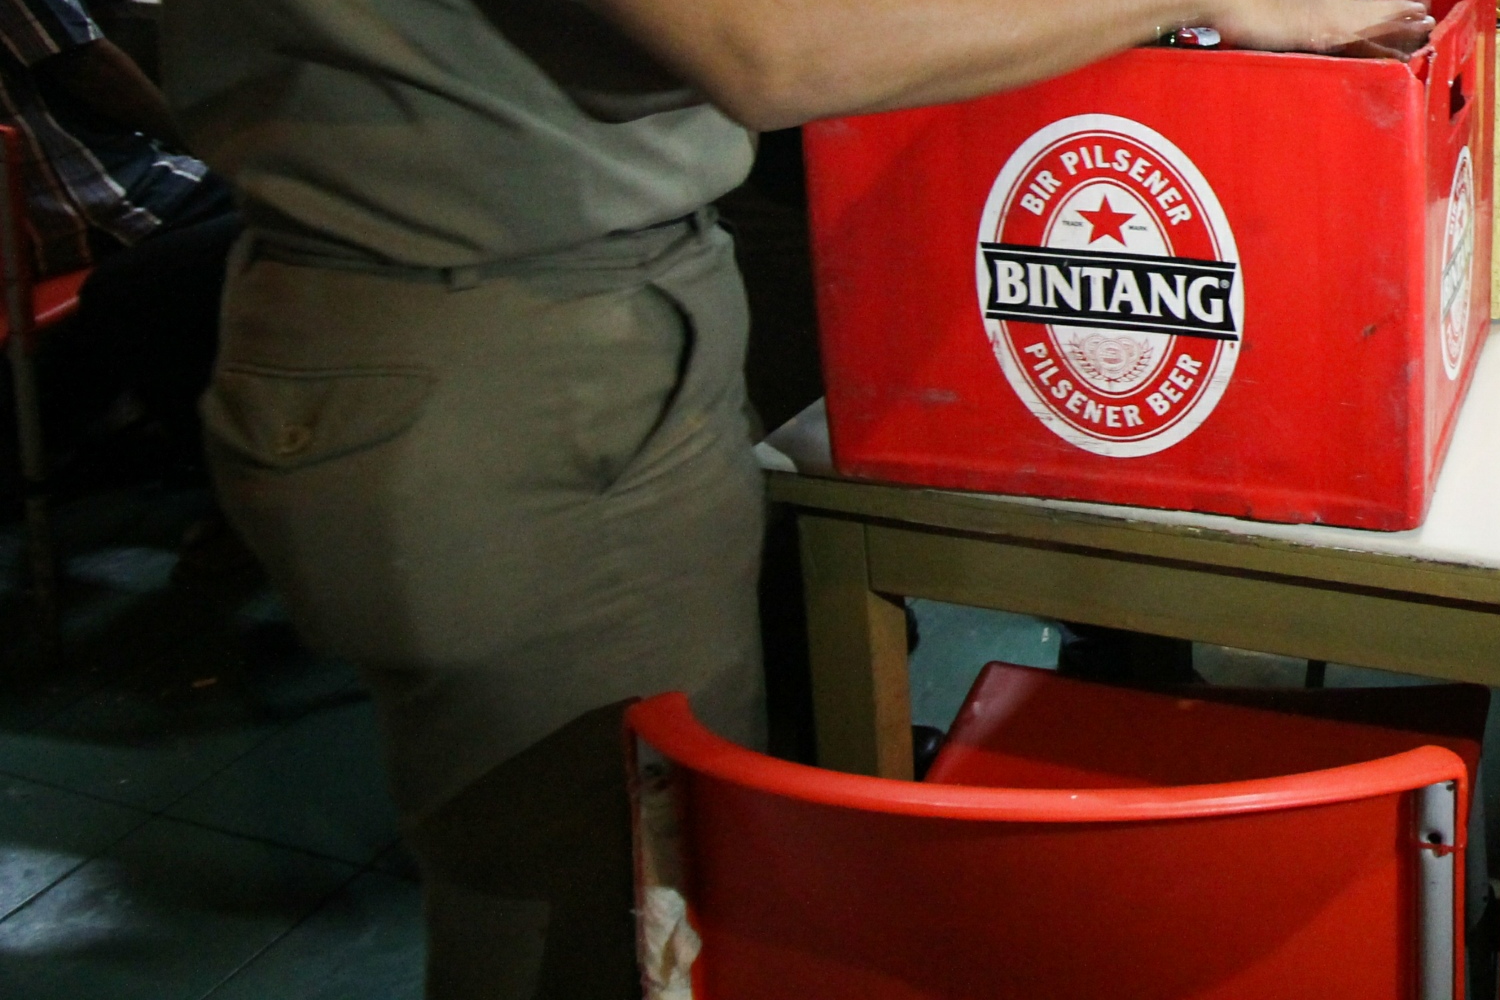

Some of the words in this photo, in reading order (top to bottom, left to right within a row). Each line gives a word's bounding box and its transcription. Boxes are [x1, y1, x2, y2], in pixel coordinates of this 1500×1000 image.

[1020, 170, 1062, 216] BIR
[1060, 145, 1192, 226] PILSENER
[993, 259, 1225, 323] BINTANG
[1024, 342, 1144, 428] PILSENER
[1145, 353, 1202, 416] BEER
